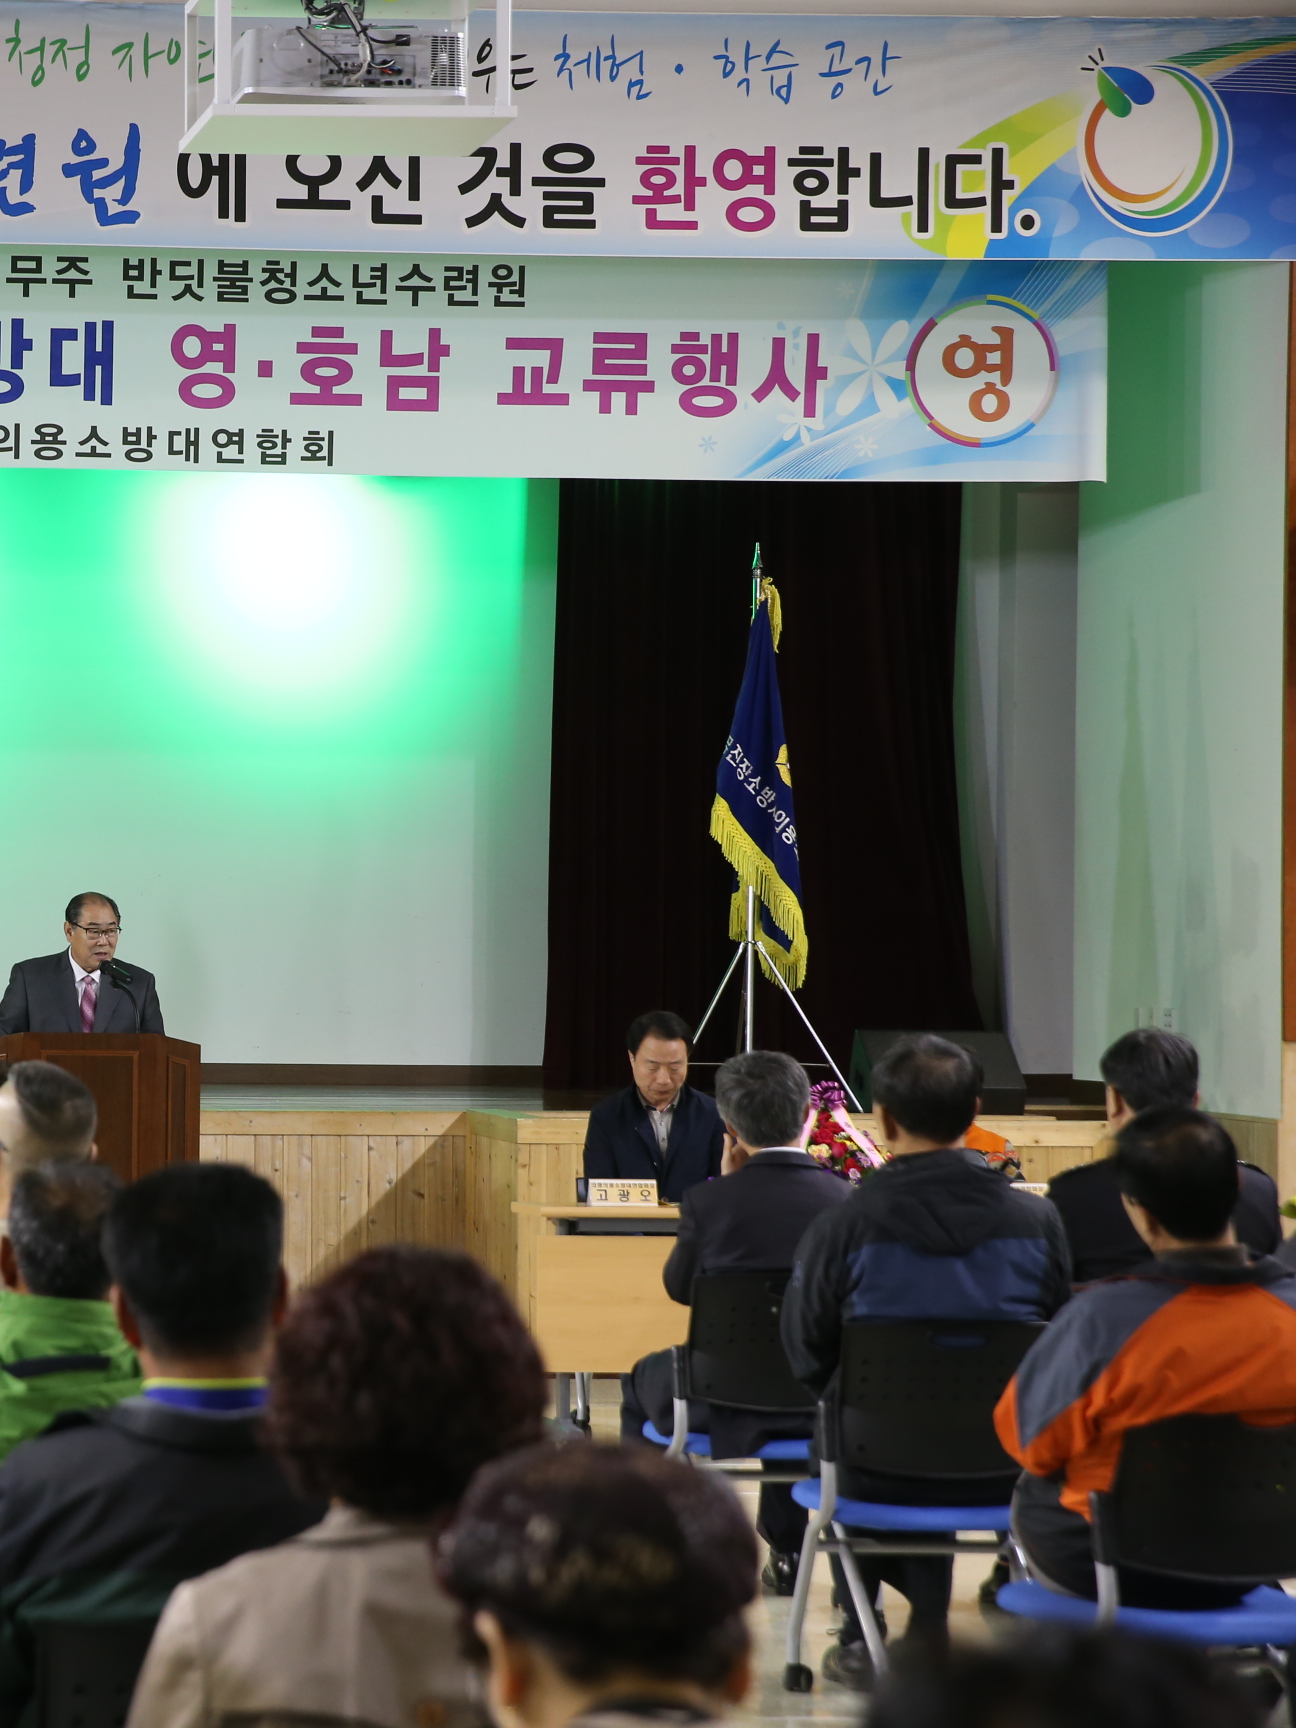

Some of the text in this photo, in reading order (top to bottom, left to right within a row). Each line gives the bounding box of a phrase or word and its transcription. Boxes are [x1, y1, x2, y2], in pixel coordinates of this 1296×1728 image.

[5, 18, 90, 87] 청정
[554, 34, 653, 100] 체험
[713, 38, 799, 105] 학습
[819, 40, 902, 99] 공간
[276, 154, 422, 225] 오신
[458, 142, 606, 229] 것을
[632, 145, 1036, 234] 환영합니다.
[5, 255, 93, 299] 무주
[122, 257, 526, 308] 반딧불청소년수련원
[170, 323, 451, 413] 영·호남
[496, 331, 829, 419] 교류행사
[941, 324, 1015, 423] 영
